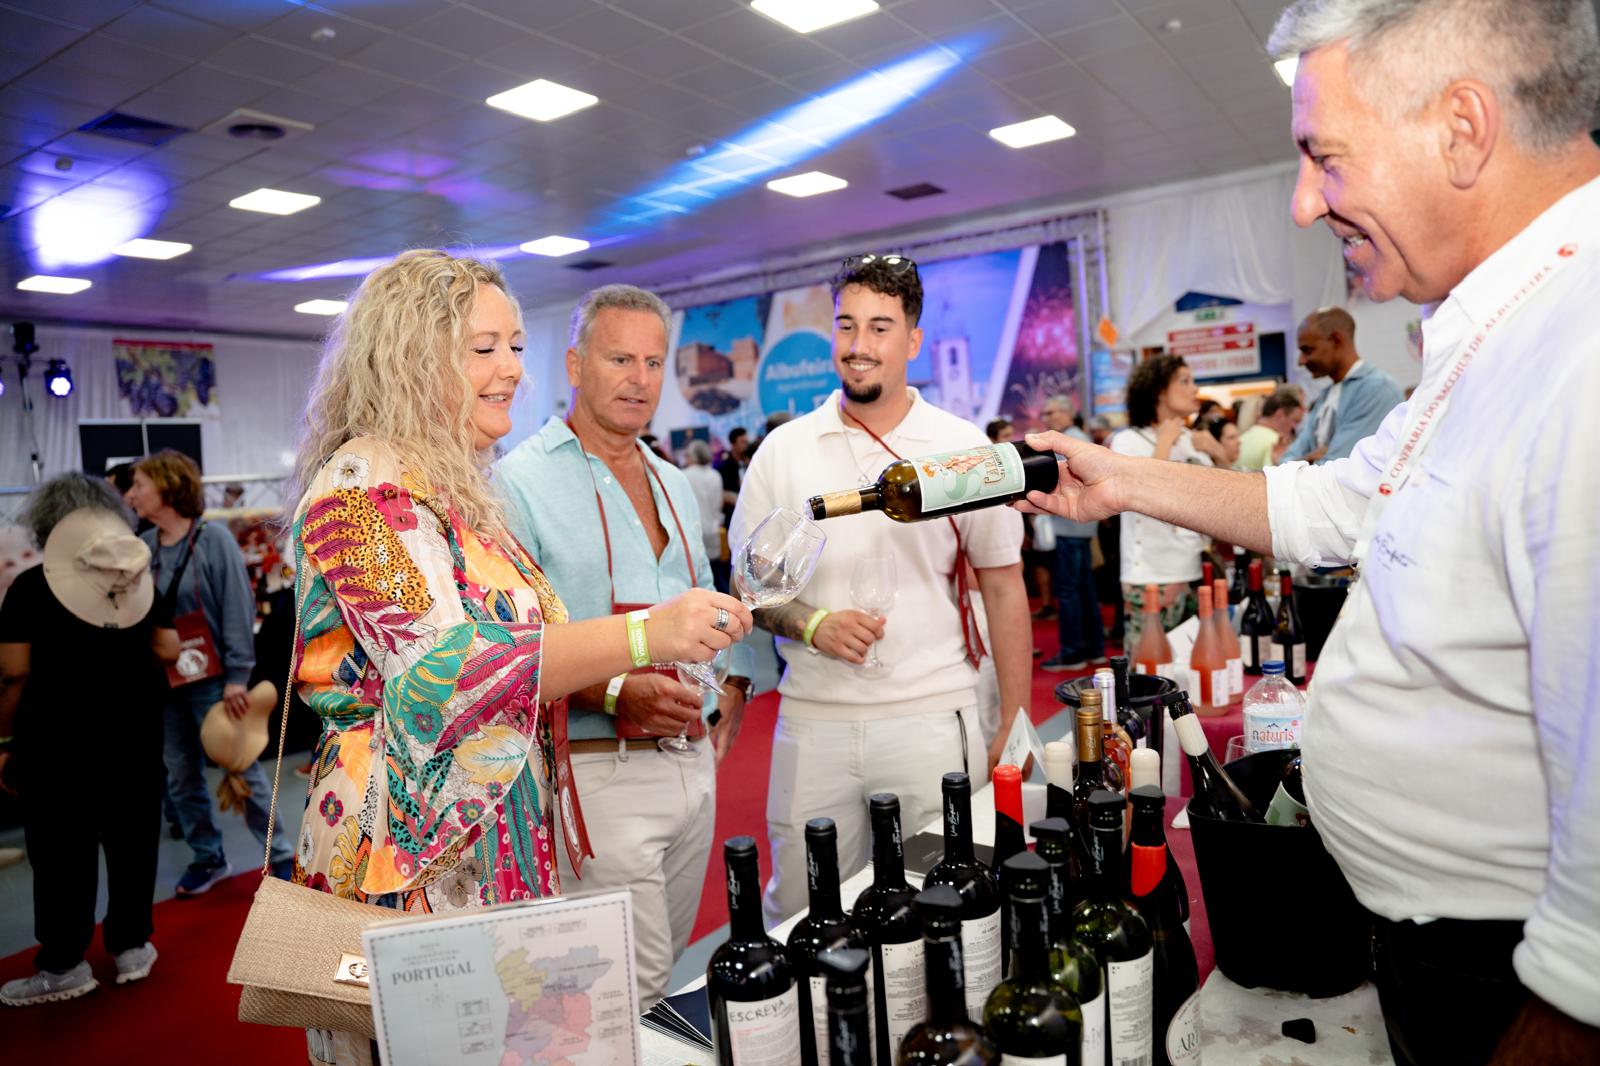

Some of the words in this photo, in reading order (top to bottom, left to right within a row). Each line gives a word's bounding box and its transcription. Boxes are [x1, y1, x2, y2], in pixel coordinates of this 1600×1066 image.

[1390, 421, 1428, 478] CONFRARIA
[1423, 401, 1439, 419] DO
[1434, 352, 1471, 401] BACCHUS
[1468, 334, 1485, 352] DE
[1485, 266, 1552, 331] ALBUFEIRA
[1252, 728, 1295, 742] naturis
[391, 961, 476, 985] PORTUGAL
[728, 999, 785, 1022] ESCREVA
